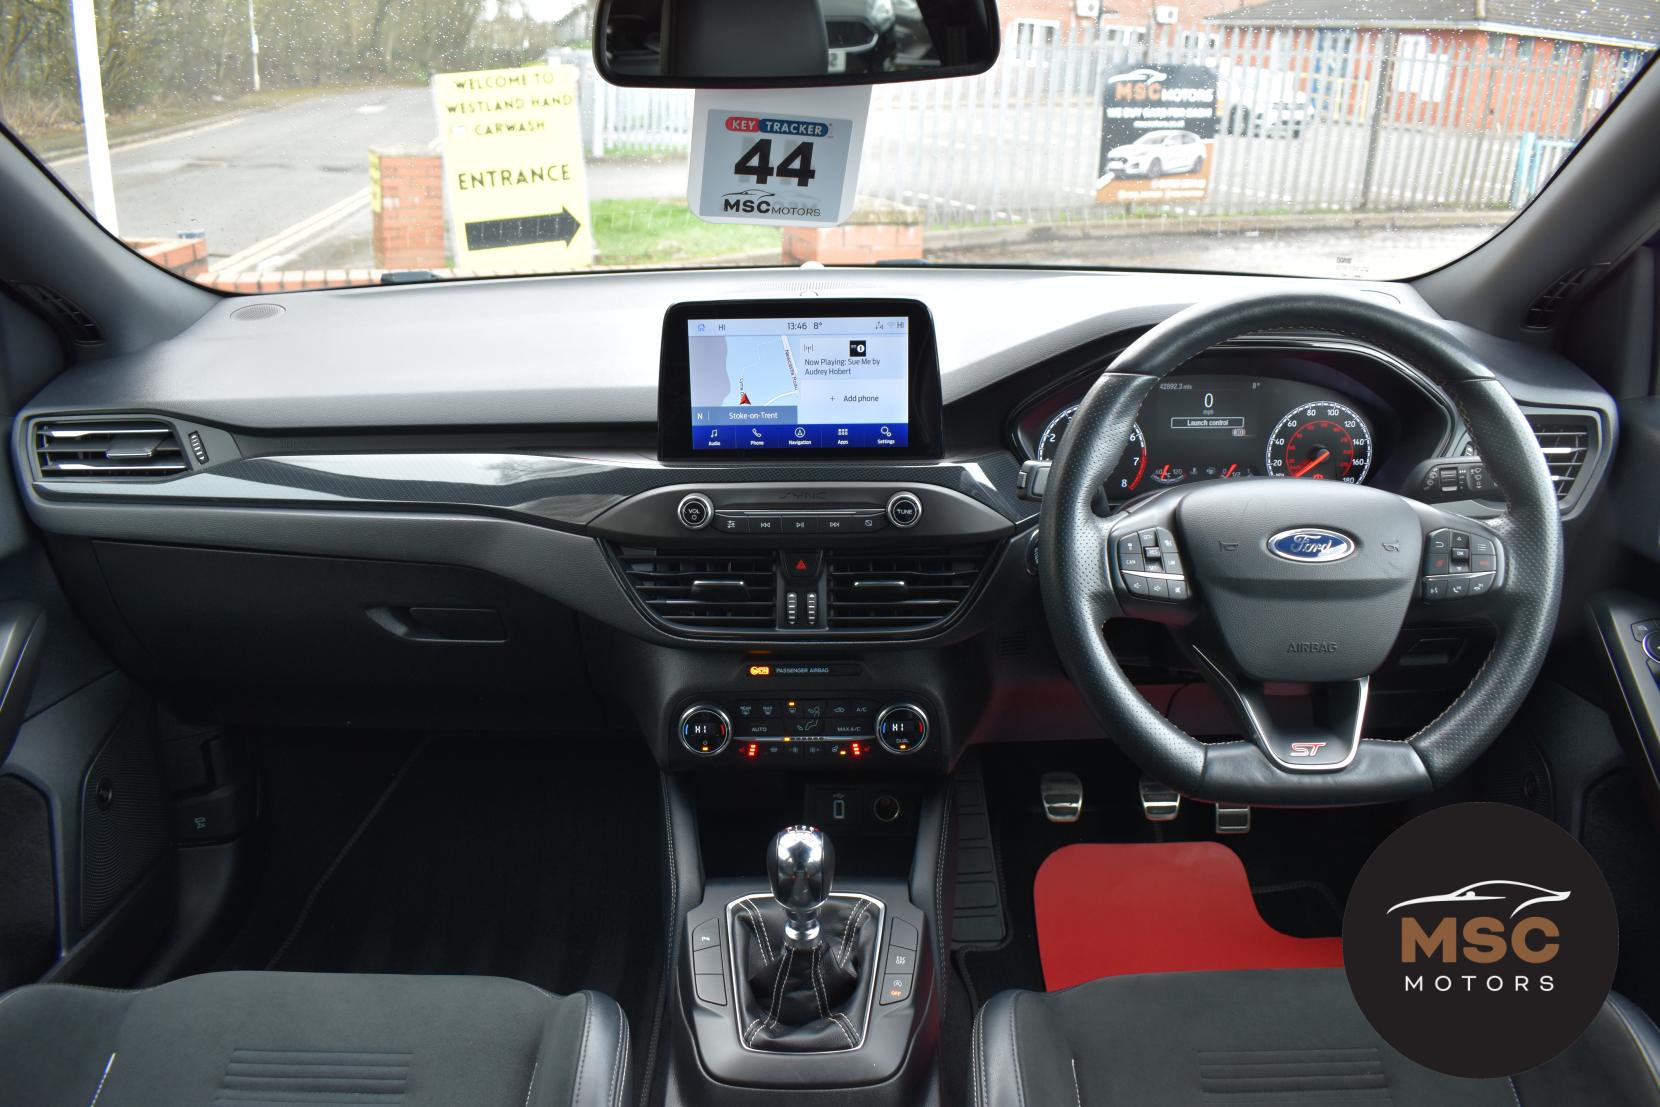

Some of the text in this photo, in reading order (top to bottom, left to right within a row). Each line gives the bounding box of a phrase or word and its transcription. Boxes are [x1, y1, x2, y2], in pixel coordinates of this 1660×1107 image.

[455, 73, 554, 89] WELCOME TO
[1114, 82, 1161, 101] MSC
[446, 94, 574, 114] WESTLAND HAND
[474, 120, 545, 135] CARWASH
[732, 119, 822, 136] KEY TRACKER
[734, 138, 816, 187] 44
[458, 164, 570, 190] ENTRANCE
[723, 199, 821, 217] MSC MOTORS
[718, 324, 726, 332] HI
[787, 321, 823, 330] 13:46 8°
[804, 358, 819, 366] Now
[820, 358, 847, 368] Playing:
[872, 358, 880, 367] by
[804, 367, 851, 378] Audrey Hobert
[859, 394, 879, 404] phone
[1204, 393, 1214, 408] 0
[728, 412, 778, 420] Stoke-on-Trent
[1050, 434, 1056, 442] 2
[1130, 433, 1136, 442] 6
[1134, 458, 1140, 466] 7
[1121, 479, 1128, 488] 8
[1291, 534, 1333, 553] Ford
[1287, 642, 1338, 654] AIRBAG
[1290, 742, 1327, 757] ST
